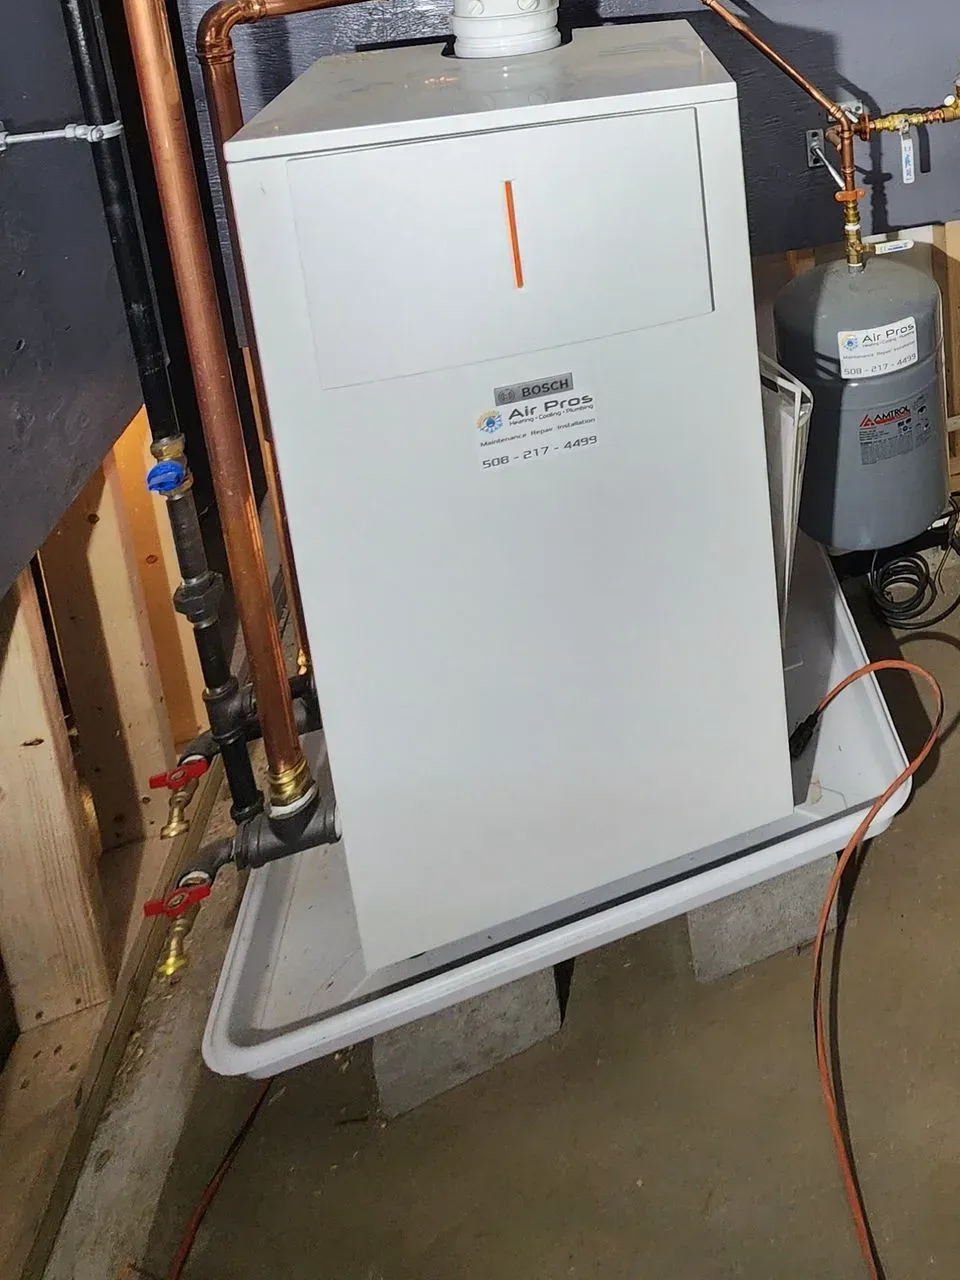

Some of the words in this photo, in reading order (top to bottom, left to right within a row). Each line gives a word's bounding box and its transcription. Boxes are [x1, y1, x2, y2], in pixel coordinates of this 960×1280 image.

[862, 333, 882, 343] Air
[886, 324, 914, 338] Pros
[871, 363, 888, 372] 217
[521, 378, 569, 398] BOSCH
[508, 406, 537, 420] Air
[544, 395, 593, 412] Pros
[509, 417, 534, 426] Heating
[538, 411, 562, 420] Cooling
[565, 404, 594, 414] Plumbing
[874, 405, 911, 422] AMTROL
[480, 433, 527, 447] Maintenance
[531, 427, 553, 436] Repair
[557, 417, 596, 430] Installation
[482, 455, 510, 469] 508
[523, 446, 550, 459] 217
[564, 435, 598, 449] 4499
